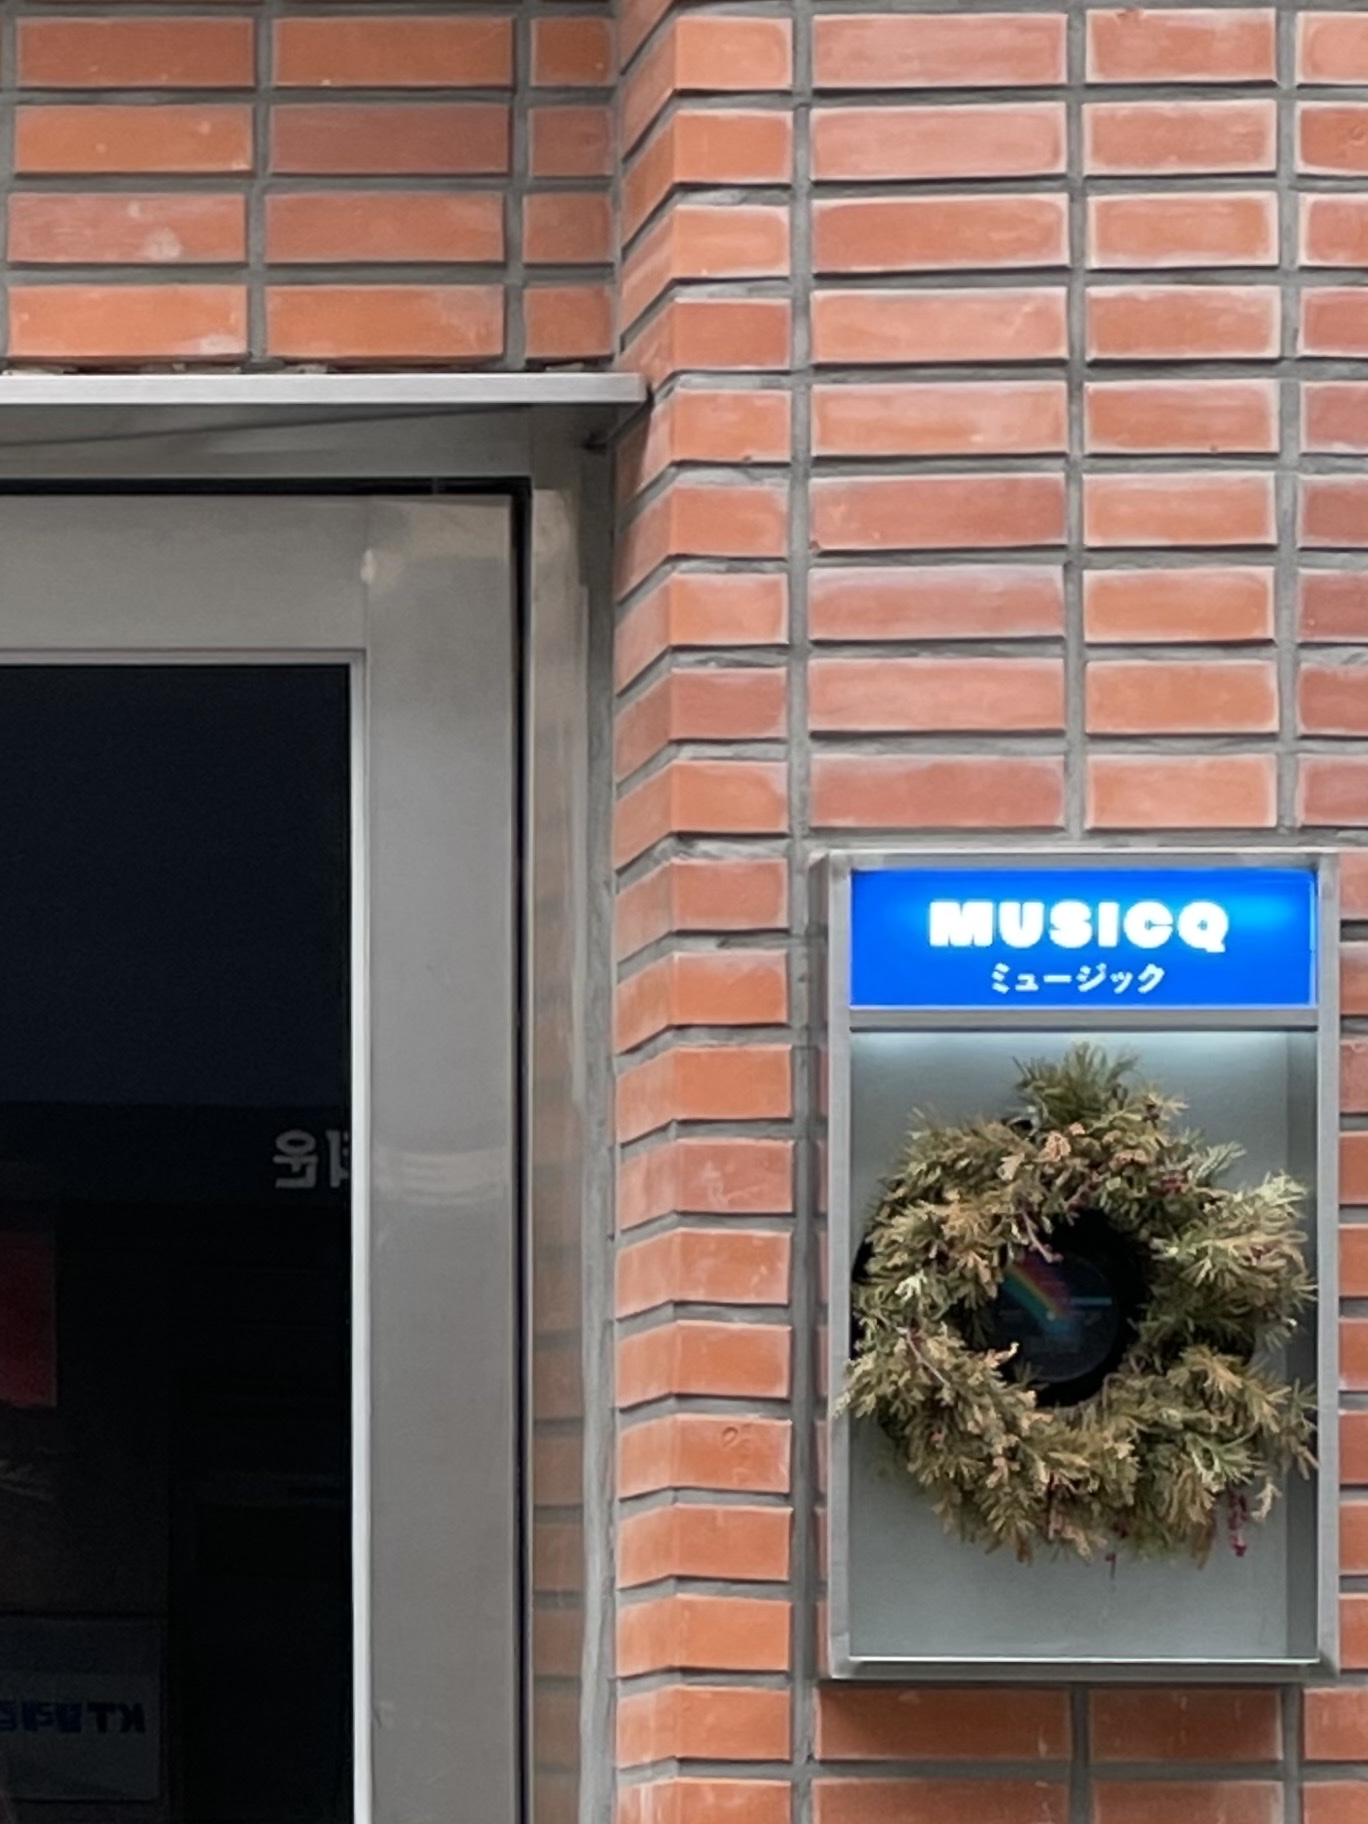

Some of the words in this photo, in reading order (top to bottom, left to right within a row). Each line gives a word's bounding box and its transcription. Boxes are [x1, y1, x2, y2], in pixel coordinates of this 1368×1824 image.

[929, 899, 1230, 953] MUSICQ
[991, 962, 1165, 994] ミュージック
